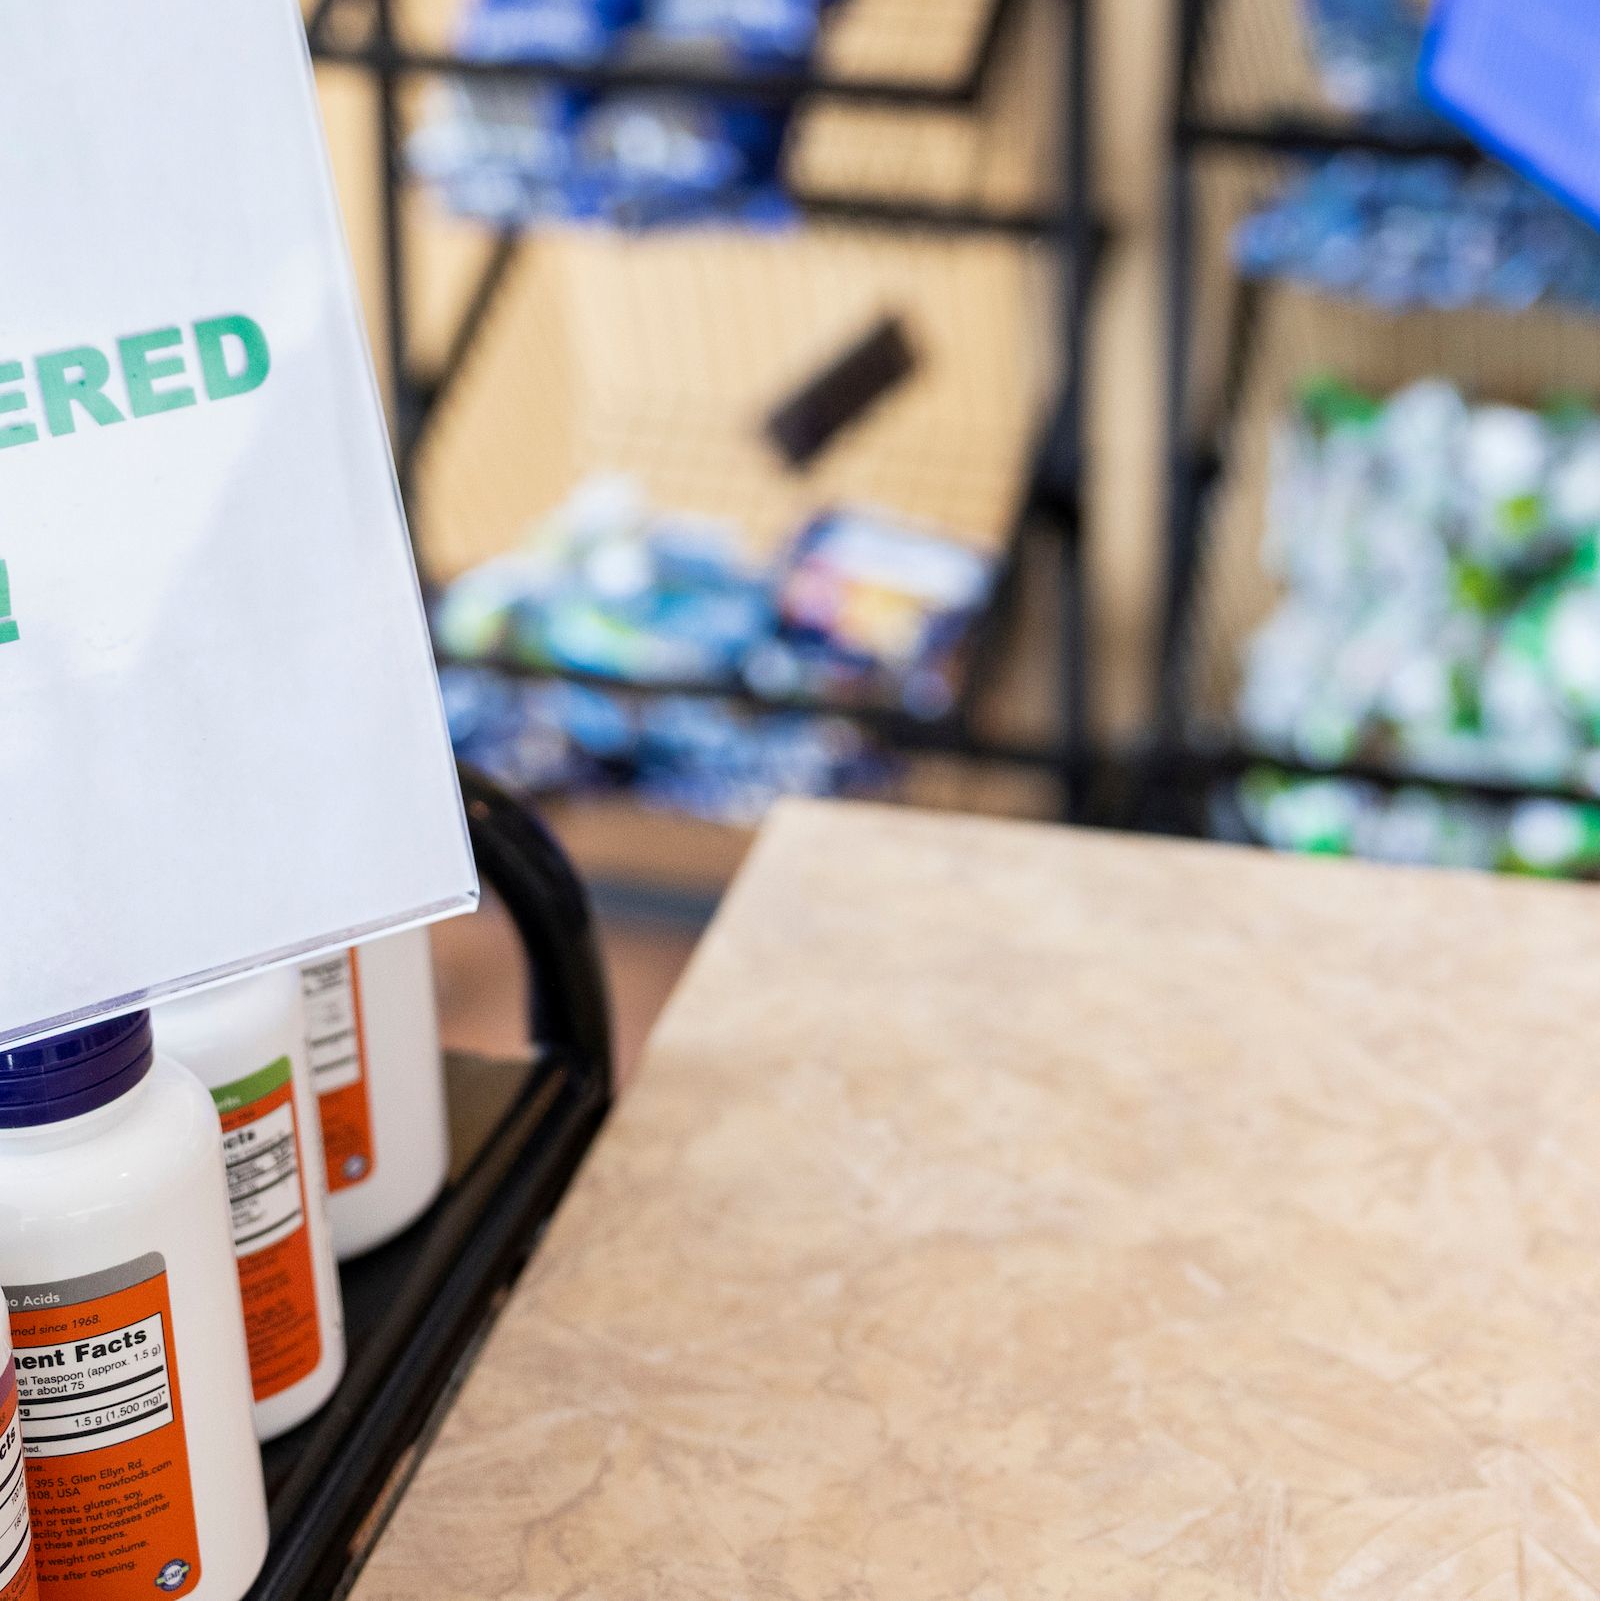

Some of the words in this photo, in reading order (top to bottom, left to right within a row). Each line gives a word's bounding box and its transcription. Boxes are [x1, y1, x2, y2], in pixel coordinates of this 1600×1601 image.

[23, 1292, 60, 1306] Acids
[11, 1325, 35, 1336] ned
[39, 1321, 67, 1334] since
[75, 1328, 147, 1363] Facts
[31, 1370, 84, 1387] Teaspoon
[87, 1358, 130, 1378] (approx.
[134, 1348, 149, 1363] 1.5
[152, 1343, 161, 1357] g)
[36, 1382, 67, 1396] about
[70, 1380, 85, 1391] 75
[74, 1417, 91, 1429] 1.5
[95, 1416, 102, 1426] g
[105, 1403, 140, 1423] (1,500
[34, 1478, 54, 1488] 395
[71, 1472, 96, 1485] Glen
[100, 1465, 125, 1480] Ellyn
[98, 1460, 173, 1491] nowfoods.com
[57, 1487, 80, 1498] USA
[61, 1516, 82, 1526] tree
[85, 1511, 104, 1523] nut
[106, 1491, 166, 1519] ingredients.
[83, 1495, 121, 1514] gluten,
[32, 1528, 63, 1541] acility
[66, 1525, 87, 1537] that
[90, 1513, 142, 1534] processes
[145, 1501, 170, 1518] other
[44, 1539, 74, 1550] these
[48, 1554, 84, 1567] weight
[87, 1550, 106, 1562] not
[108, 1539, 149, 1557] volume.
[63, 1570, 87, 1582] after
